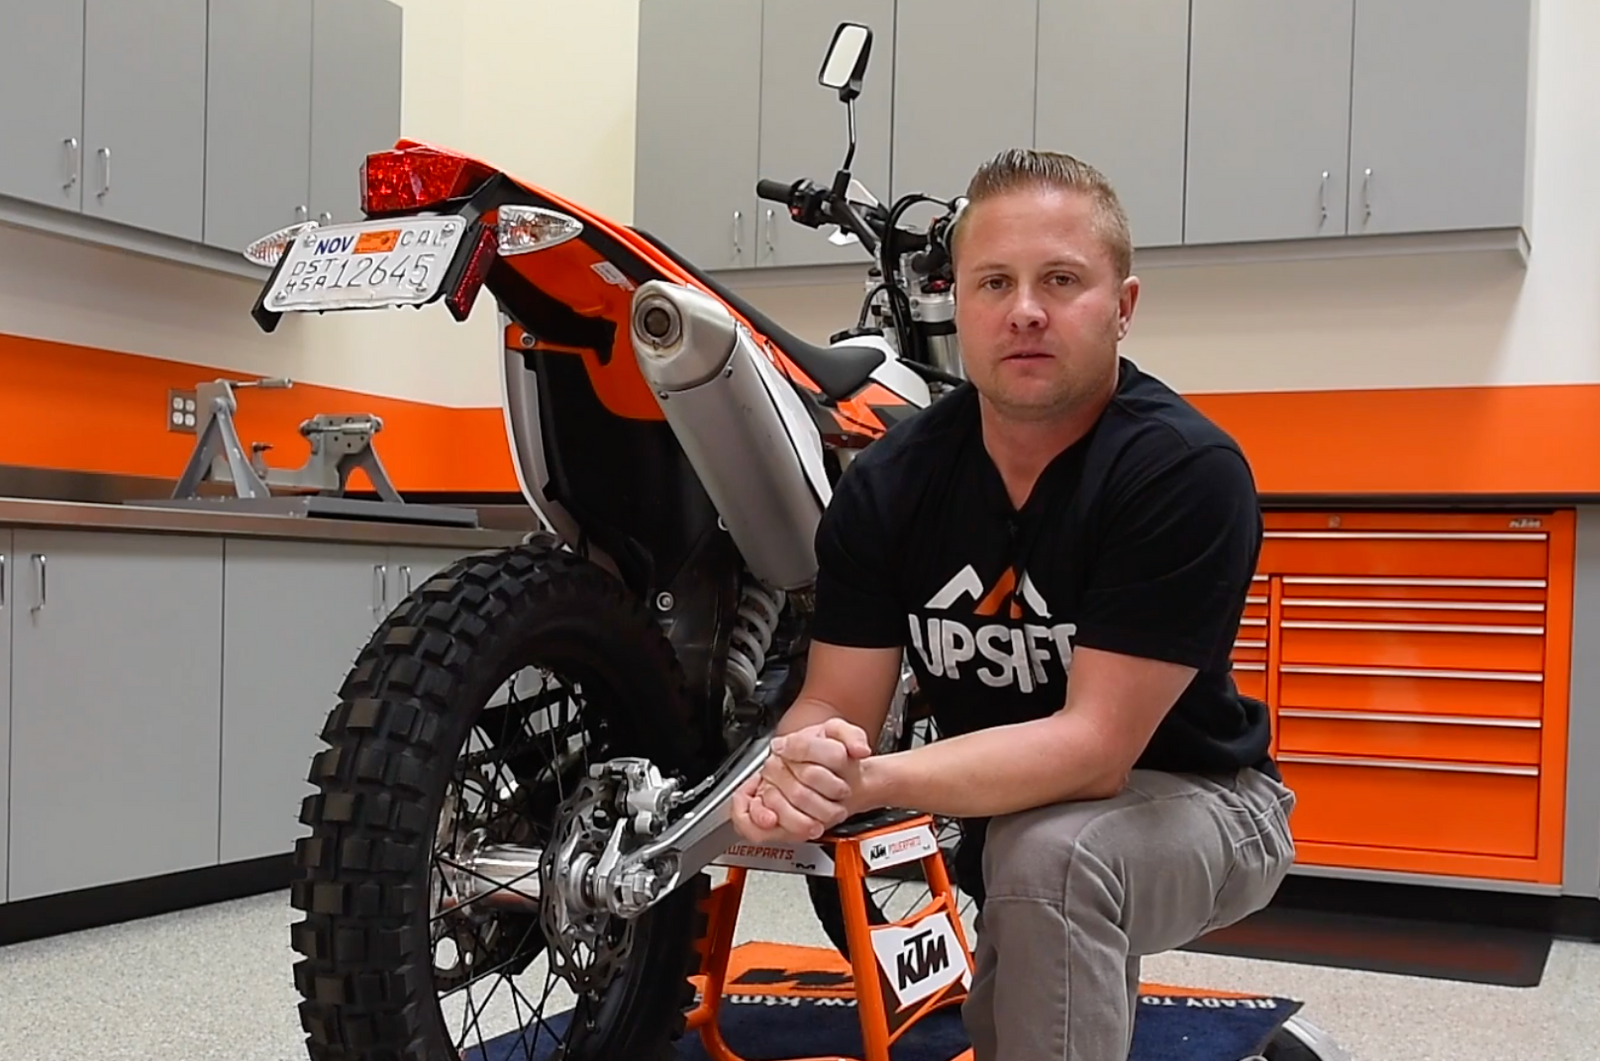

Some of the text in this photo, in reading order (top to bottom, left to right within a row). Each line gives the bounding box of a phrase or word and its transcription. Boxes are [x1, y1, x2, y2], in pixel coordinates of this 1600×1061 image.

[313, 235, 355, 256] NOV
[291, 257, 340, 277] DST
[327, 253, 435, 290] 12645
[723, 845, 794, 860] WERPARTS
[870, 843, 887, 861] KTM
[896, 928, 950, 992] KTM
[1141, 996, 1278, 1010] READY TO
